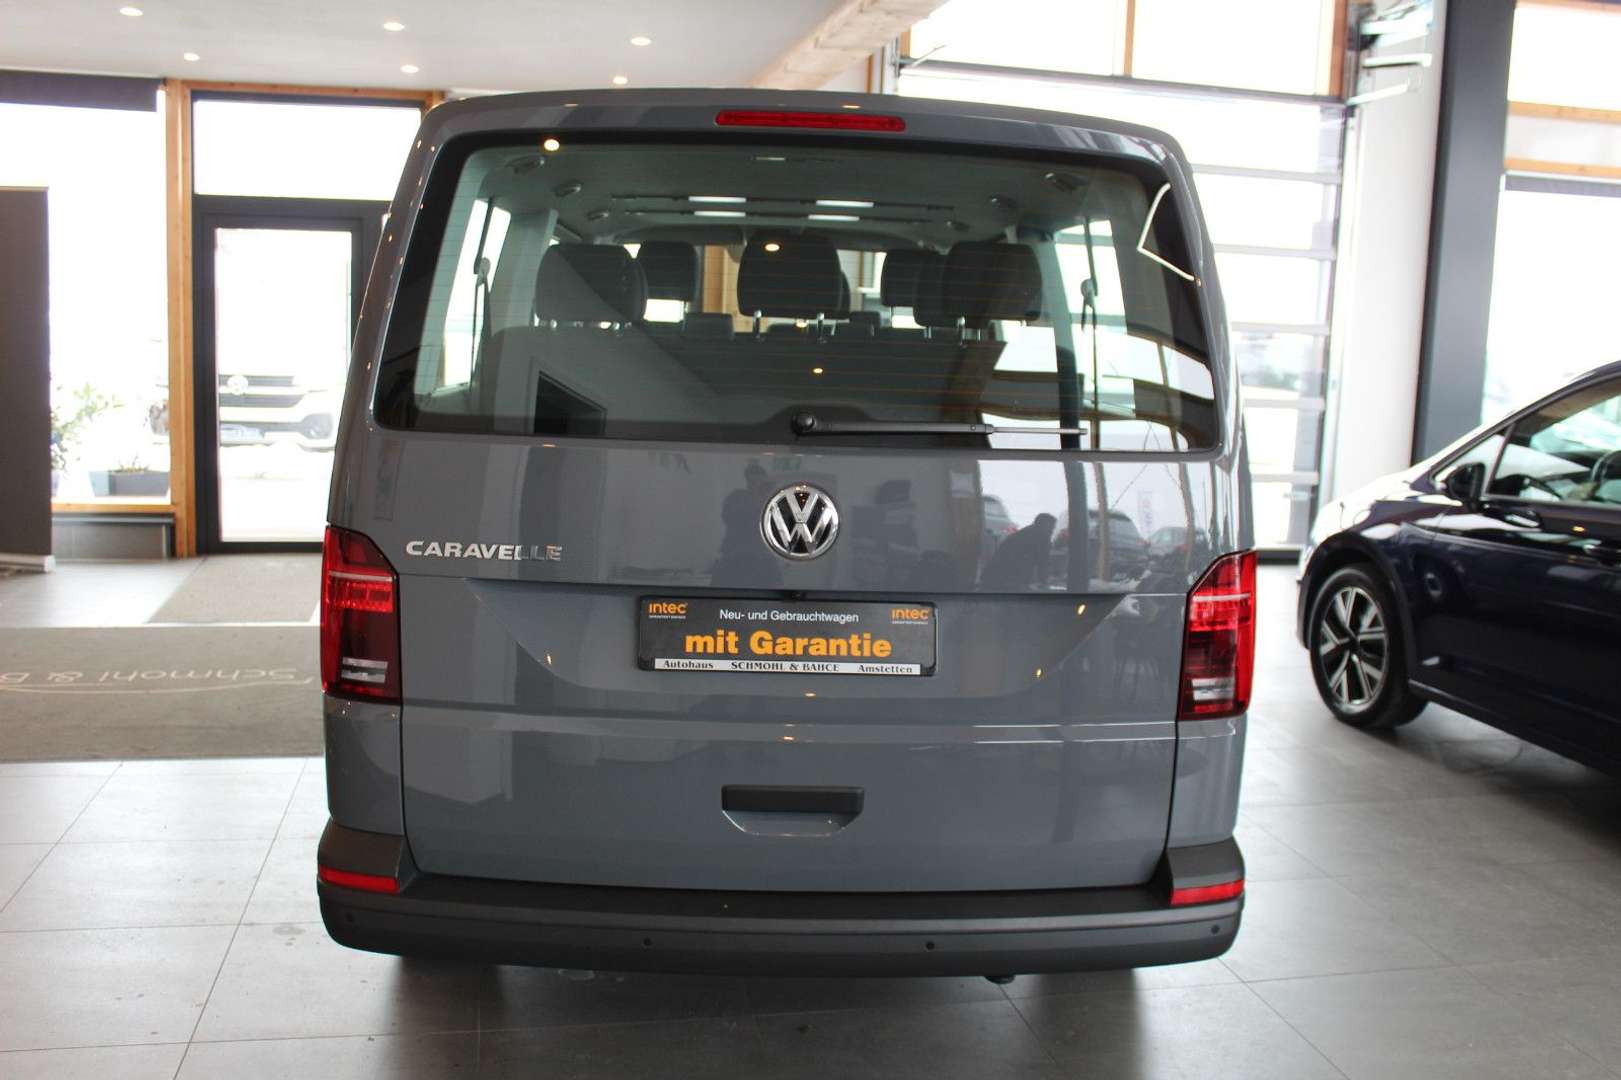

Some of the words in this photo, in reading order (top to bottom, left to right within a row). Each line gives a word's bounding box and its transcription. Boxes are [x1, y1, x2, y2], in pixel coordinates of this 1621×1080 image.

[405, 540, 563, 562] CARAVELLE
[648, 602, 687, 614] intec
[891, 608, 930, 621] intec
[719, 609, 745, 621] Neu-
[747, 610, 768, 622] und
[770, 610, 860, 624] Gebrauchtwagen
[684, 629, 738, 653] mit
[750, 630, 892, 657] Garantie
[663, 660, 714, 670] Autohaus
[731, 661, 785, 671] SCHMOHL
[858, 665, 913, 674] Amstetten
